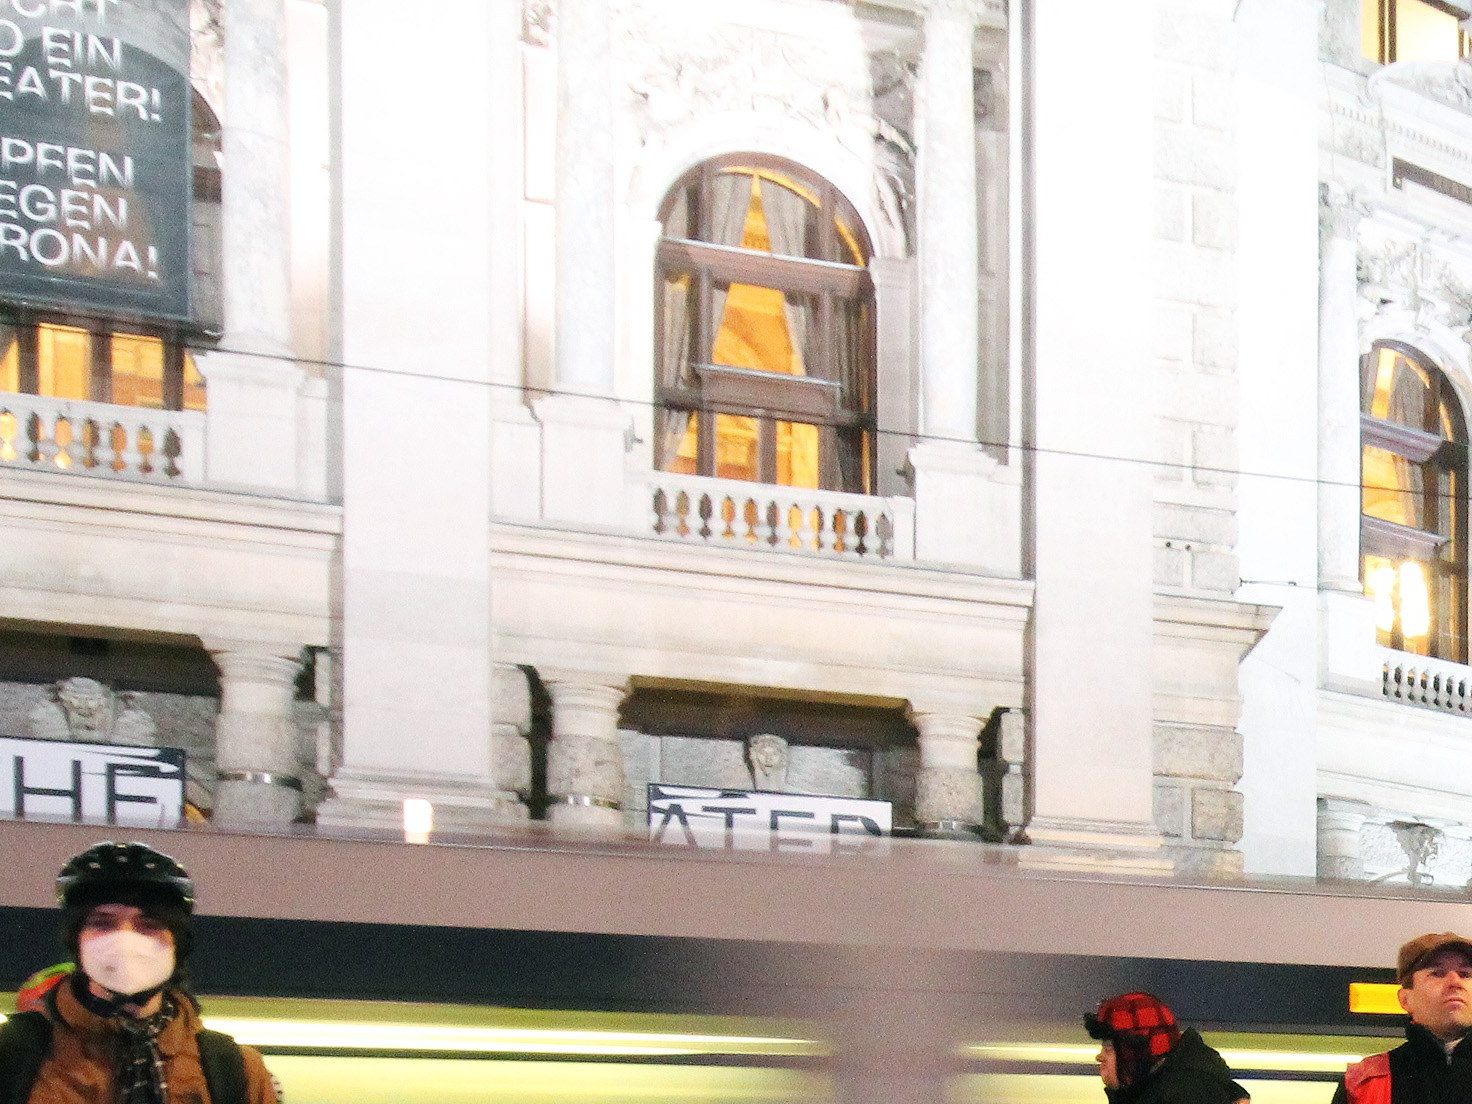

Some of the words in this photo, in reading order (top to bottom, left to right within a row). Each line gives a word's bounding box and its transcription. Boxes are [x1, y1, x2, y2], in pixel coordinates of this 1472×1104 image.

[42, 26, 122, 72] EIN
[1, 136, 135, 188] PFEN
[0, 222, 160, 279] RONA!
